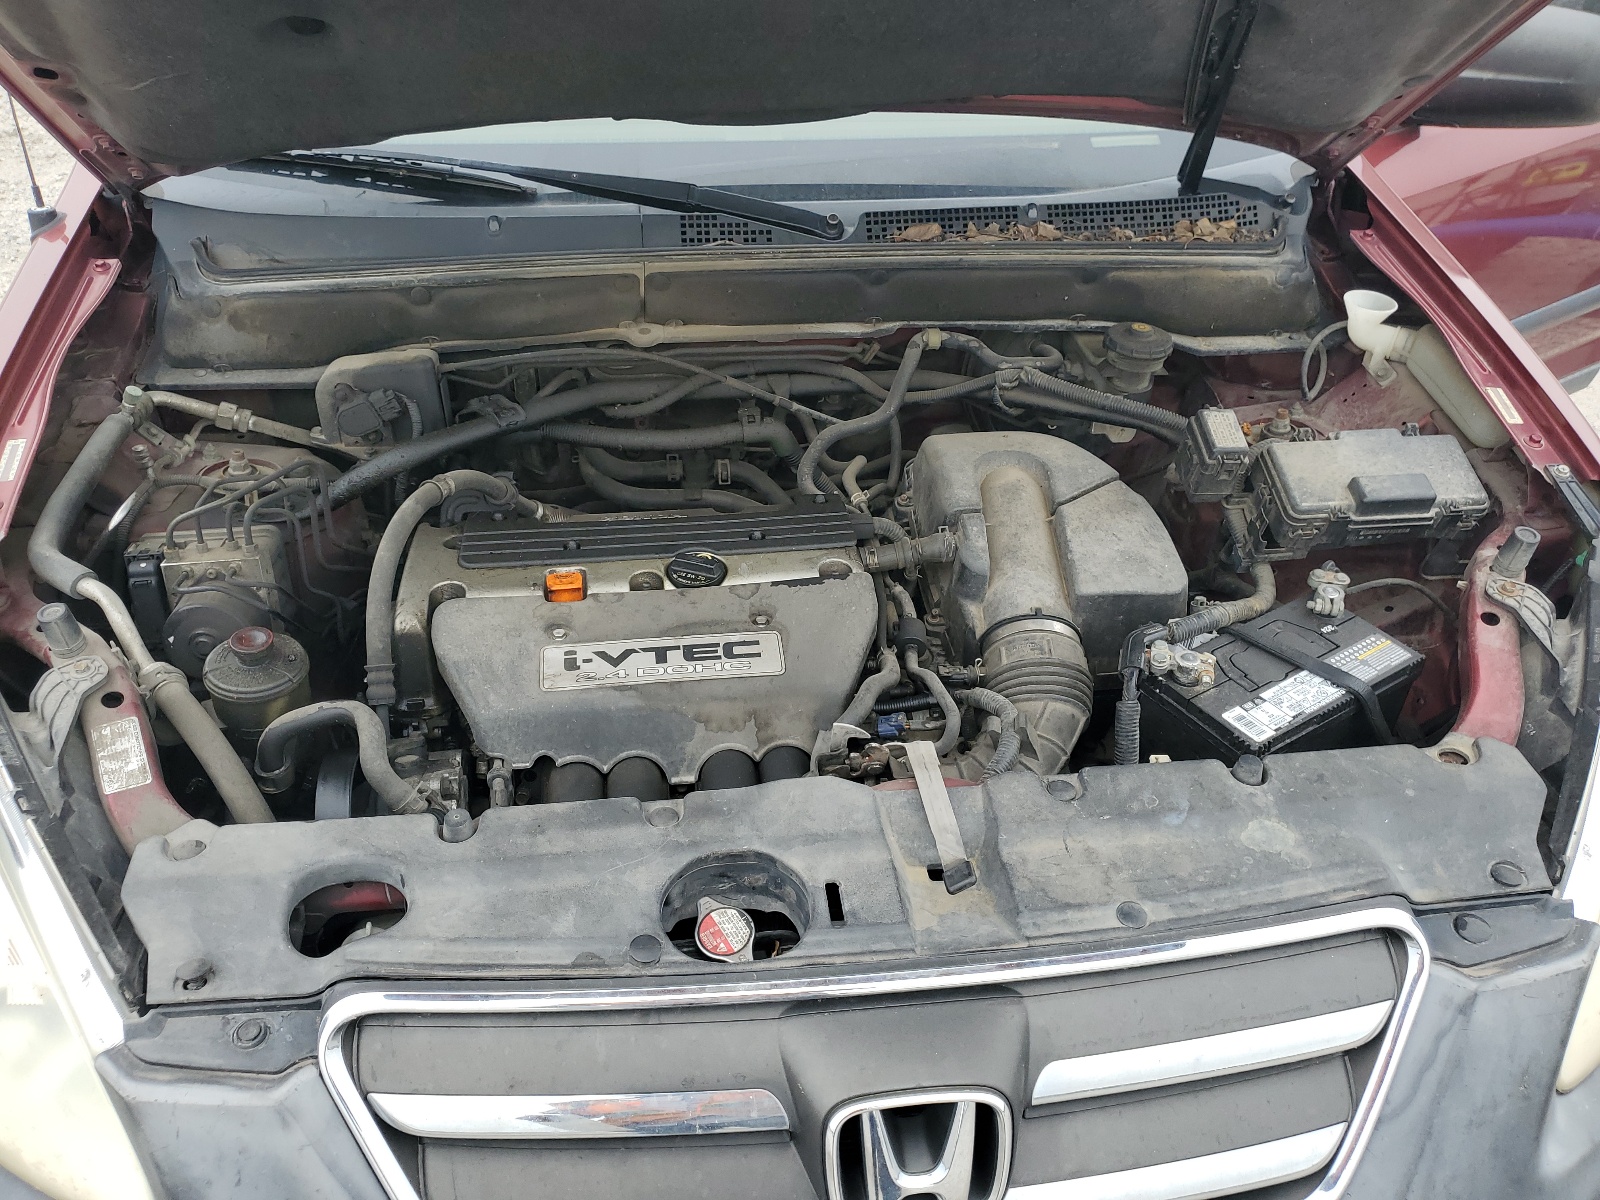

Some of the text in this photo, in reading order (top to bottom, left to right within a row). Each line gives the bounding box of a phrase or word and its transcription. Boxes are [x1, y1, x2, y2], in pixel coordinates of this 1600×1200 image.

[563, 640, 762, 671] i-VTEC
[575, 661, 751, 683] 2.4 DOHC
